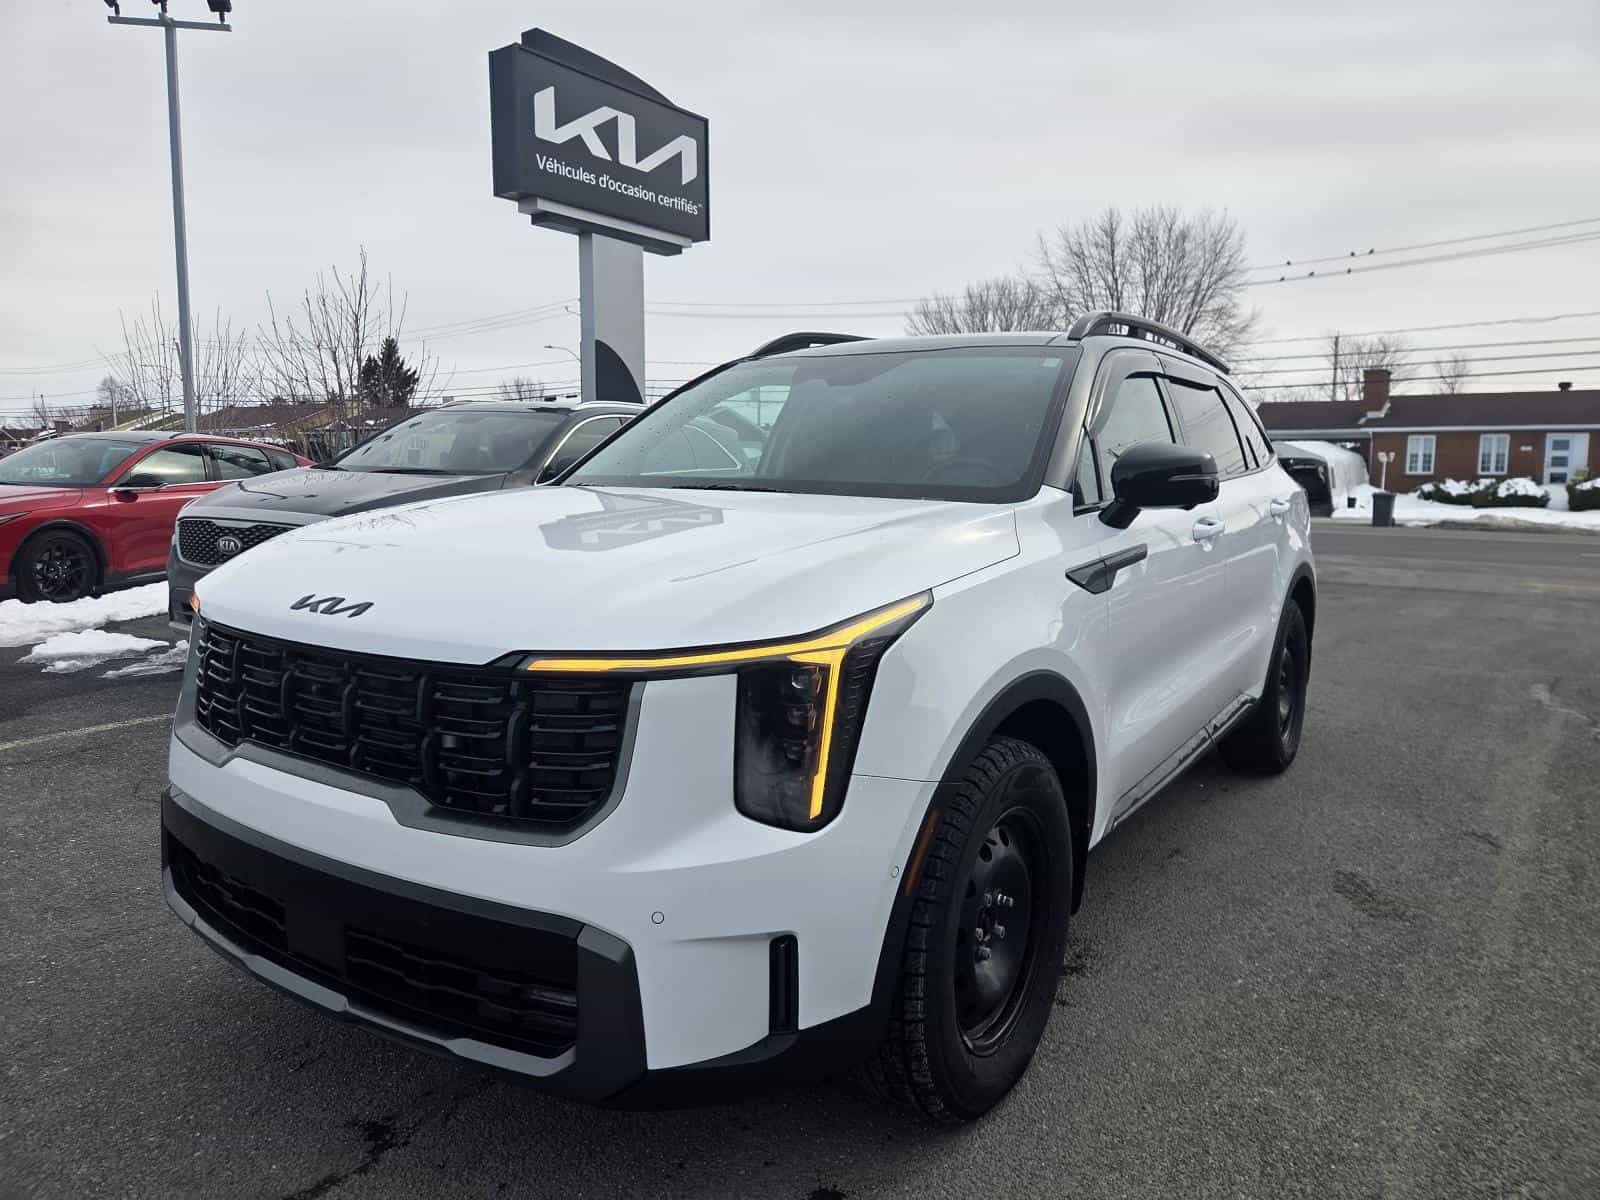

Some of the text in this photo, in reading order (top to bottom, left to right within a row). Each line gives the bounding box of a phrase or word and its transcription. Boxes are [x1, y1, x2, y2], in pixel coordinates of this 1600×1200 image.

[533, 86, 698, 185] KIA
[536, 153, 699, 215] Véhicules d'occasion certifiés
[219, 540, 236, 551] KIA
[290, 594, 375, 618] KIA
